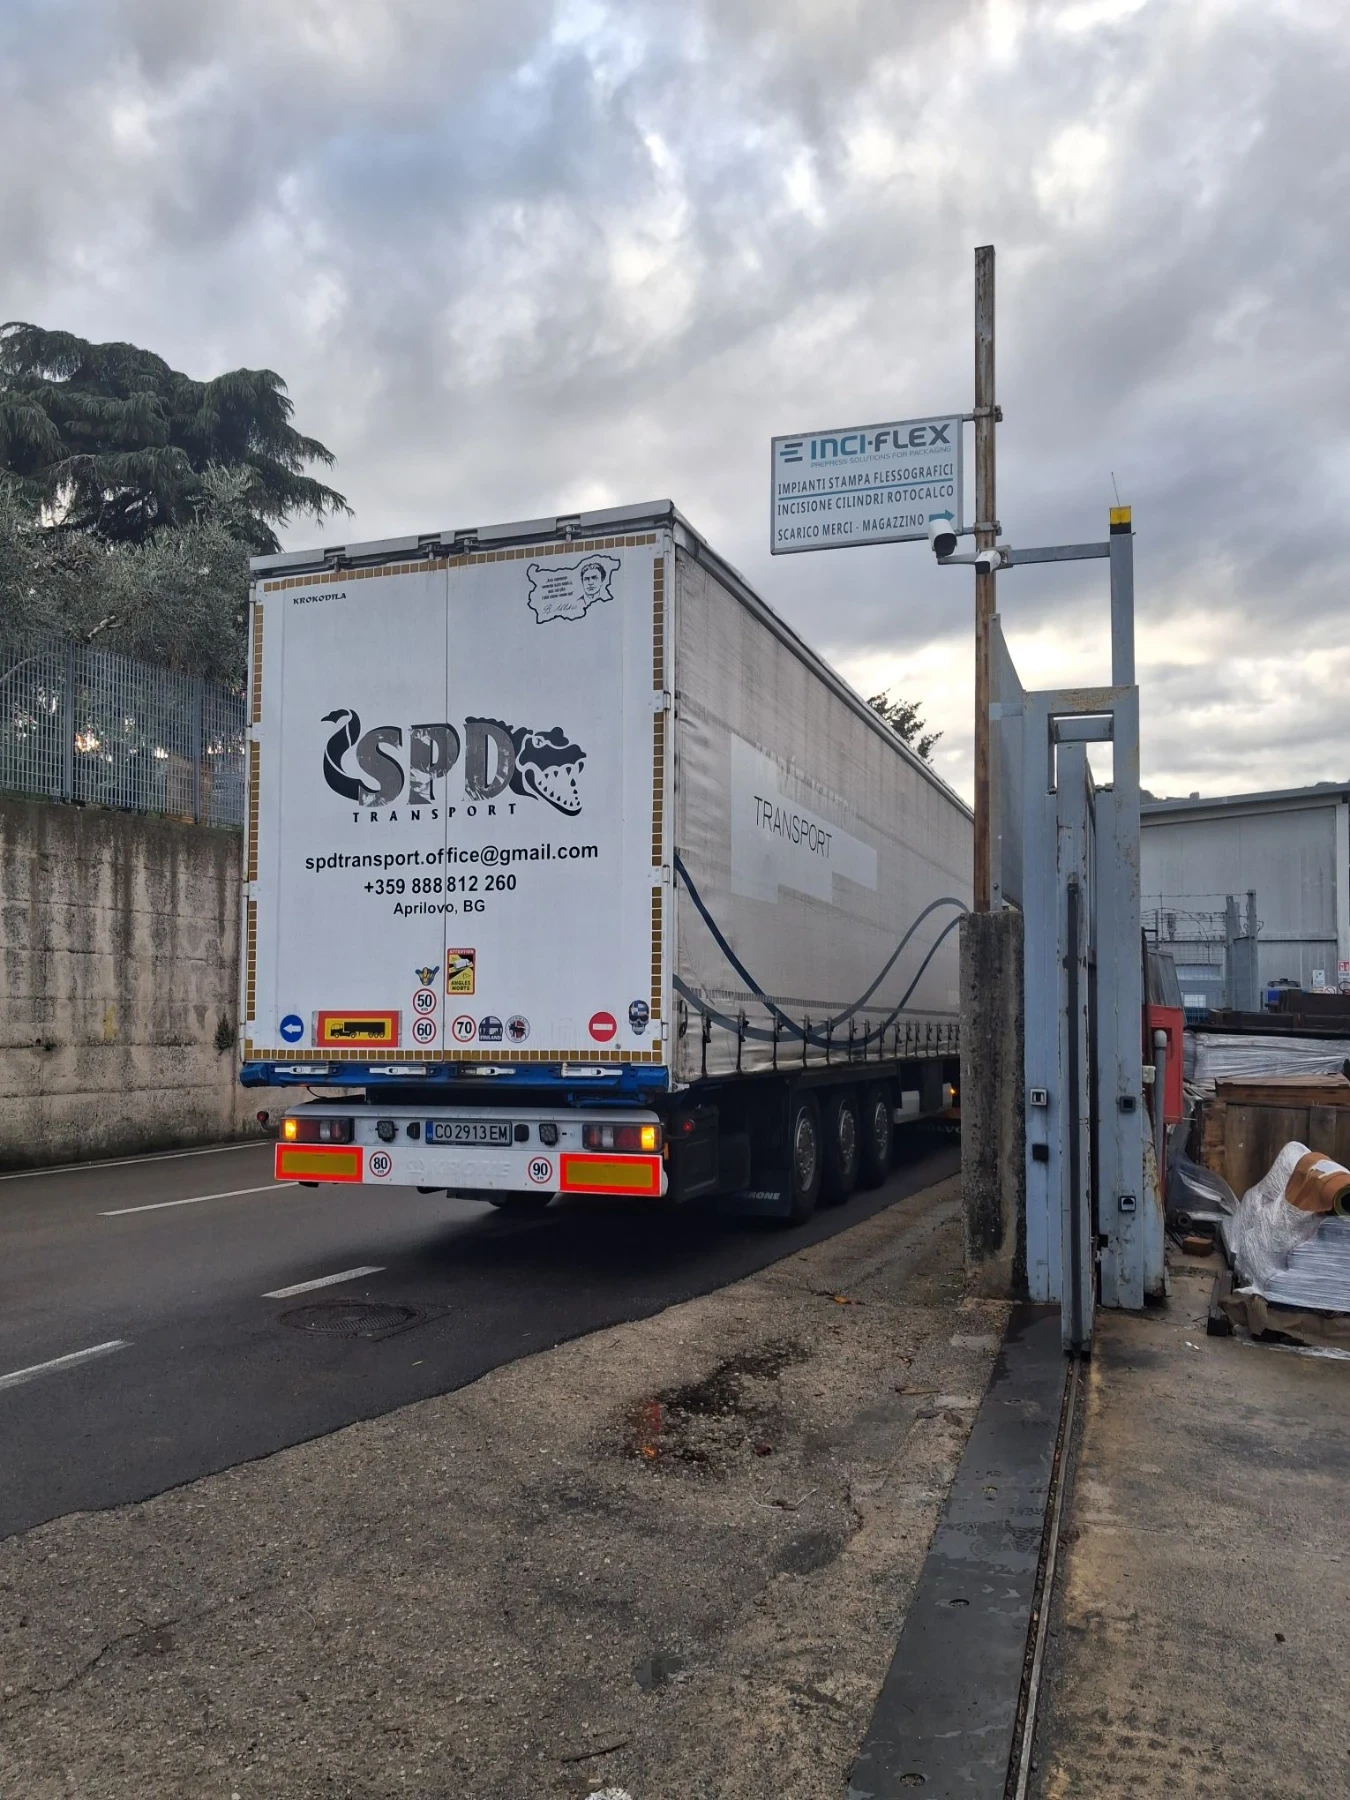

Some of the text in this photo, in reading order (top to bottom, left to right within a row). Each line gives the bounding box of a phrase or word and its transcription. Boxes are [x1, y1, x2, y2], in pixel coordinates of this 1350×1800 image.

[811, 446, 952, 468] PREPRESS SOLUTIONS FOR PACKAGING
[778, 463, 954, 495] IMPIANTI STAMPA FLESSOGRAFICI
[777, 485, 954, 516] INCISIONE CILINDRI ROTOCALCO
[778, 525, 819, 541] SCARICO
[822, 521, 853, 536] MERCI
[862, 513, 924, 532] MAGAZZINO
[293, 592, 347, 605] KROKODILA
[356, 722, 516, 807] SPD
[353, 803, 517, 822] TRANSPORT
[753, 795, 833, 859] TRANSPORT
[305, 843, 598, 873] spdtransport.office@gmail.com
[364, 874, 517, 895] +359 888 812 260
[393, 899, 486, 917] Aprilovo, BG
[417, 994, 432, 1008] 50
[417, 1023, 432, 1037] 60
[456, 1021, 472, 1035] 70
[455, 1124, 487, 1140] 2913
[489, 1125, 508, 1141] EM
[373, 1156, 388, 1170] 80
[533, 1162, 548, 1176] 90
